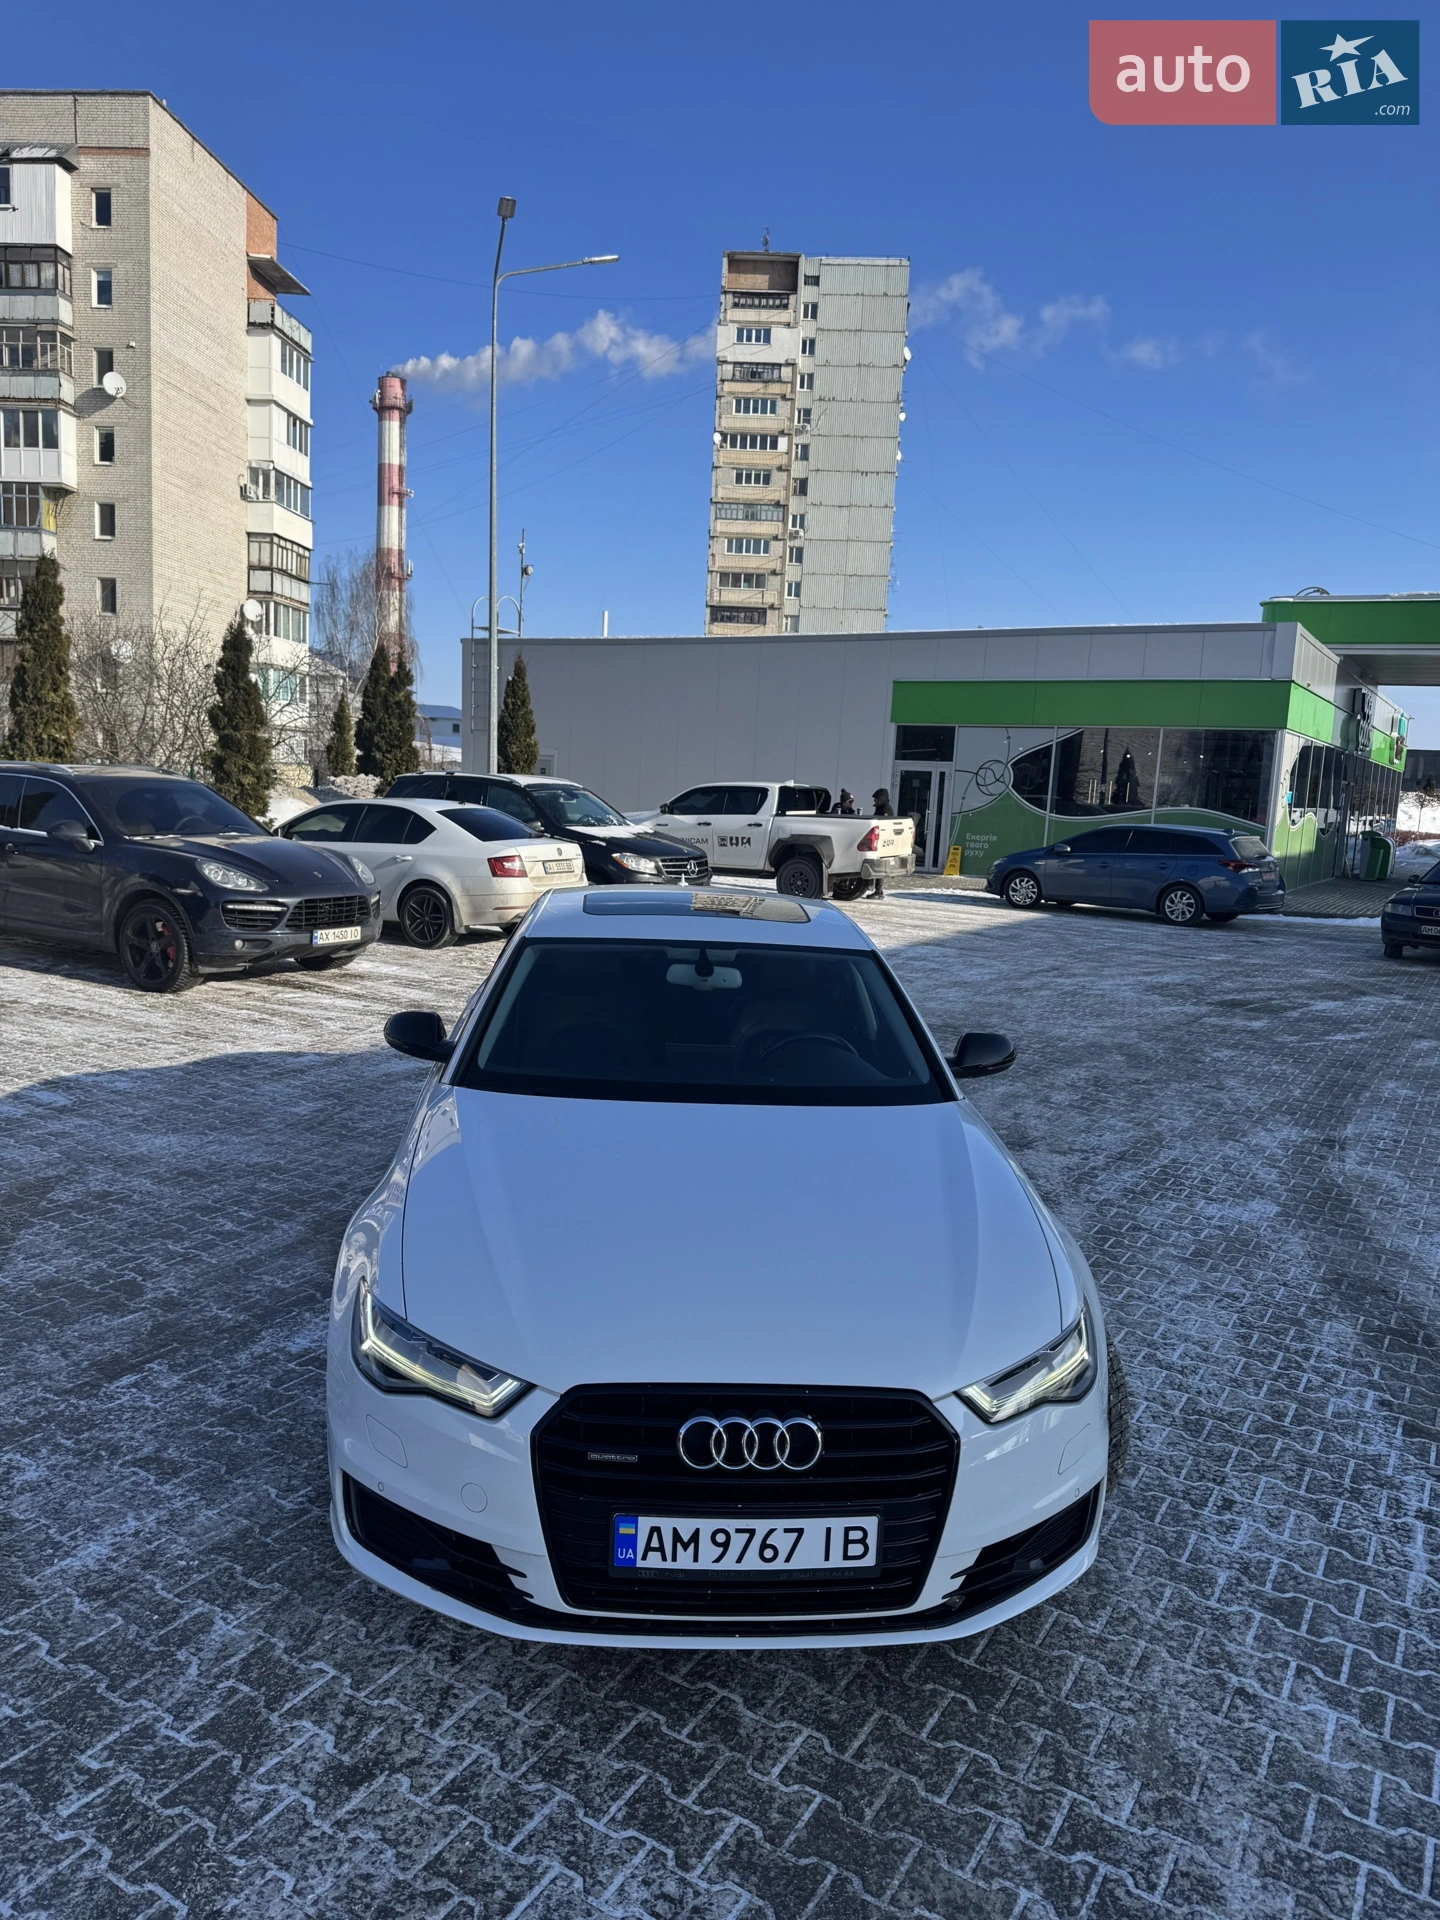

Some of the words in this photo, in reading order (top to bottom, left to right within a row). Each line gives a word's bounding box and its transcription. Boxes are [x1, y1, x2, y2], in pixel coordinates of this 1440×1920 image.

[966, 833, 997, 842] Енергія
[964, 849, 984, 857] руху
[319, 931, 330, 942] AX
[332, 930, 348, 941] 1450
[589, 1453, 636, 1461] quattro
[640, 1525, 701, 1563] AM
[709, 1527, 805, 1564] 9767
[823, 1525, 870, 1562] IB
[617, 1548, 635, 1559] UA
